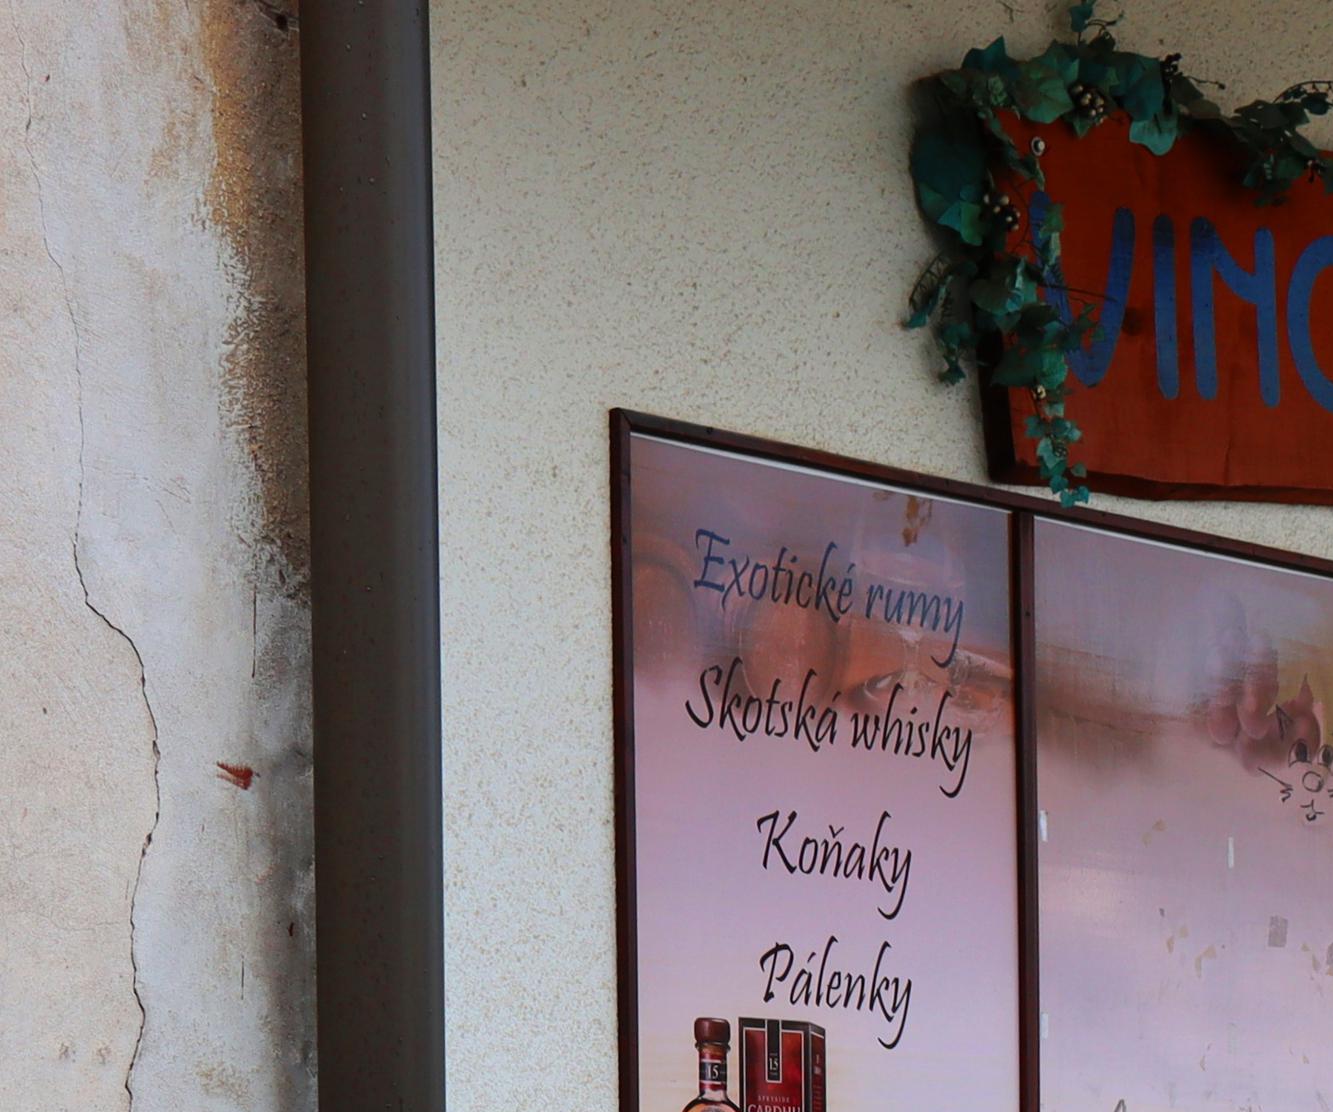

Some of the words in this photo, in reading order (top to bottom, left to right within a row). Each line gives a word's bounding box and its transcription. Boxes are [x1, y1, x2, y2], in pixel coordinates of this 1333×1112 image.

[693, 528, 856, 623] Exotické
[863, 584, 965, 669] rumy
[685, 656, 842, 753] Skotská
[850, 682, 973, 798] whisky
[757, 809, 913, 920] Koňaky
[759, 936, 913, 1049] Pálenky
[706, 1064, 719, 1079] 15
[769, 1057, 779, 1071] 15
